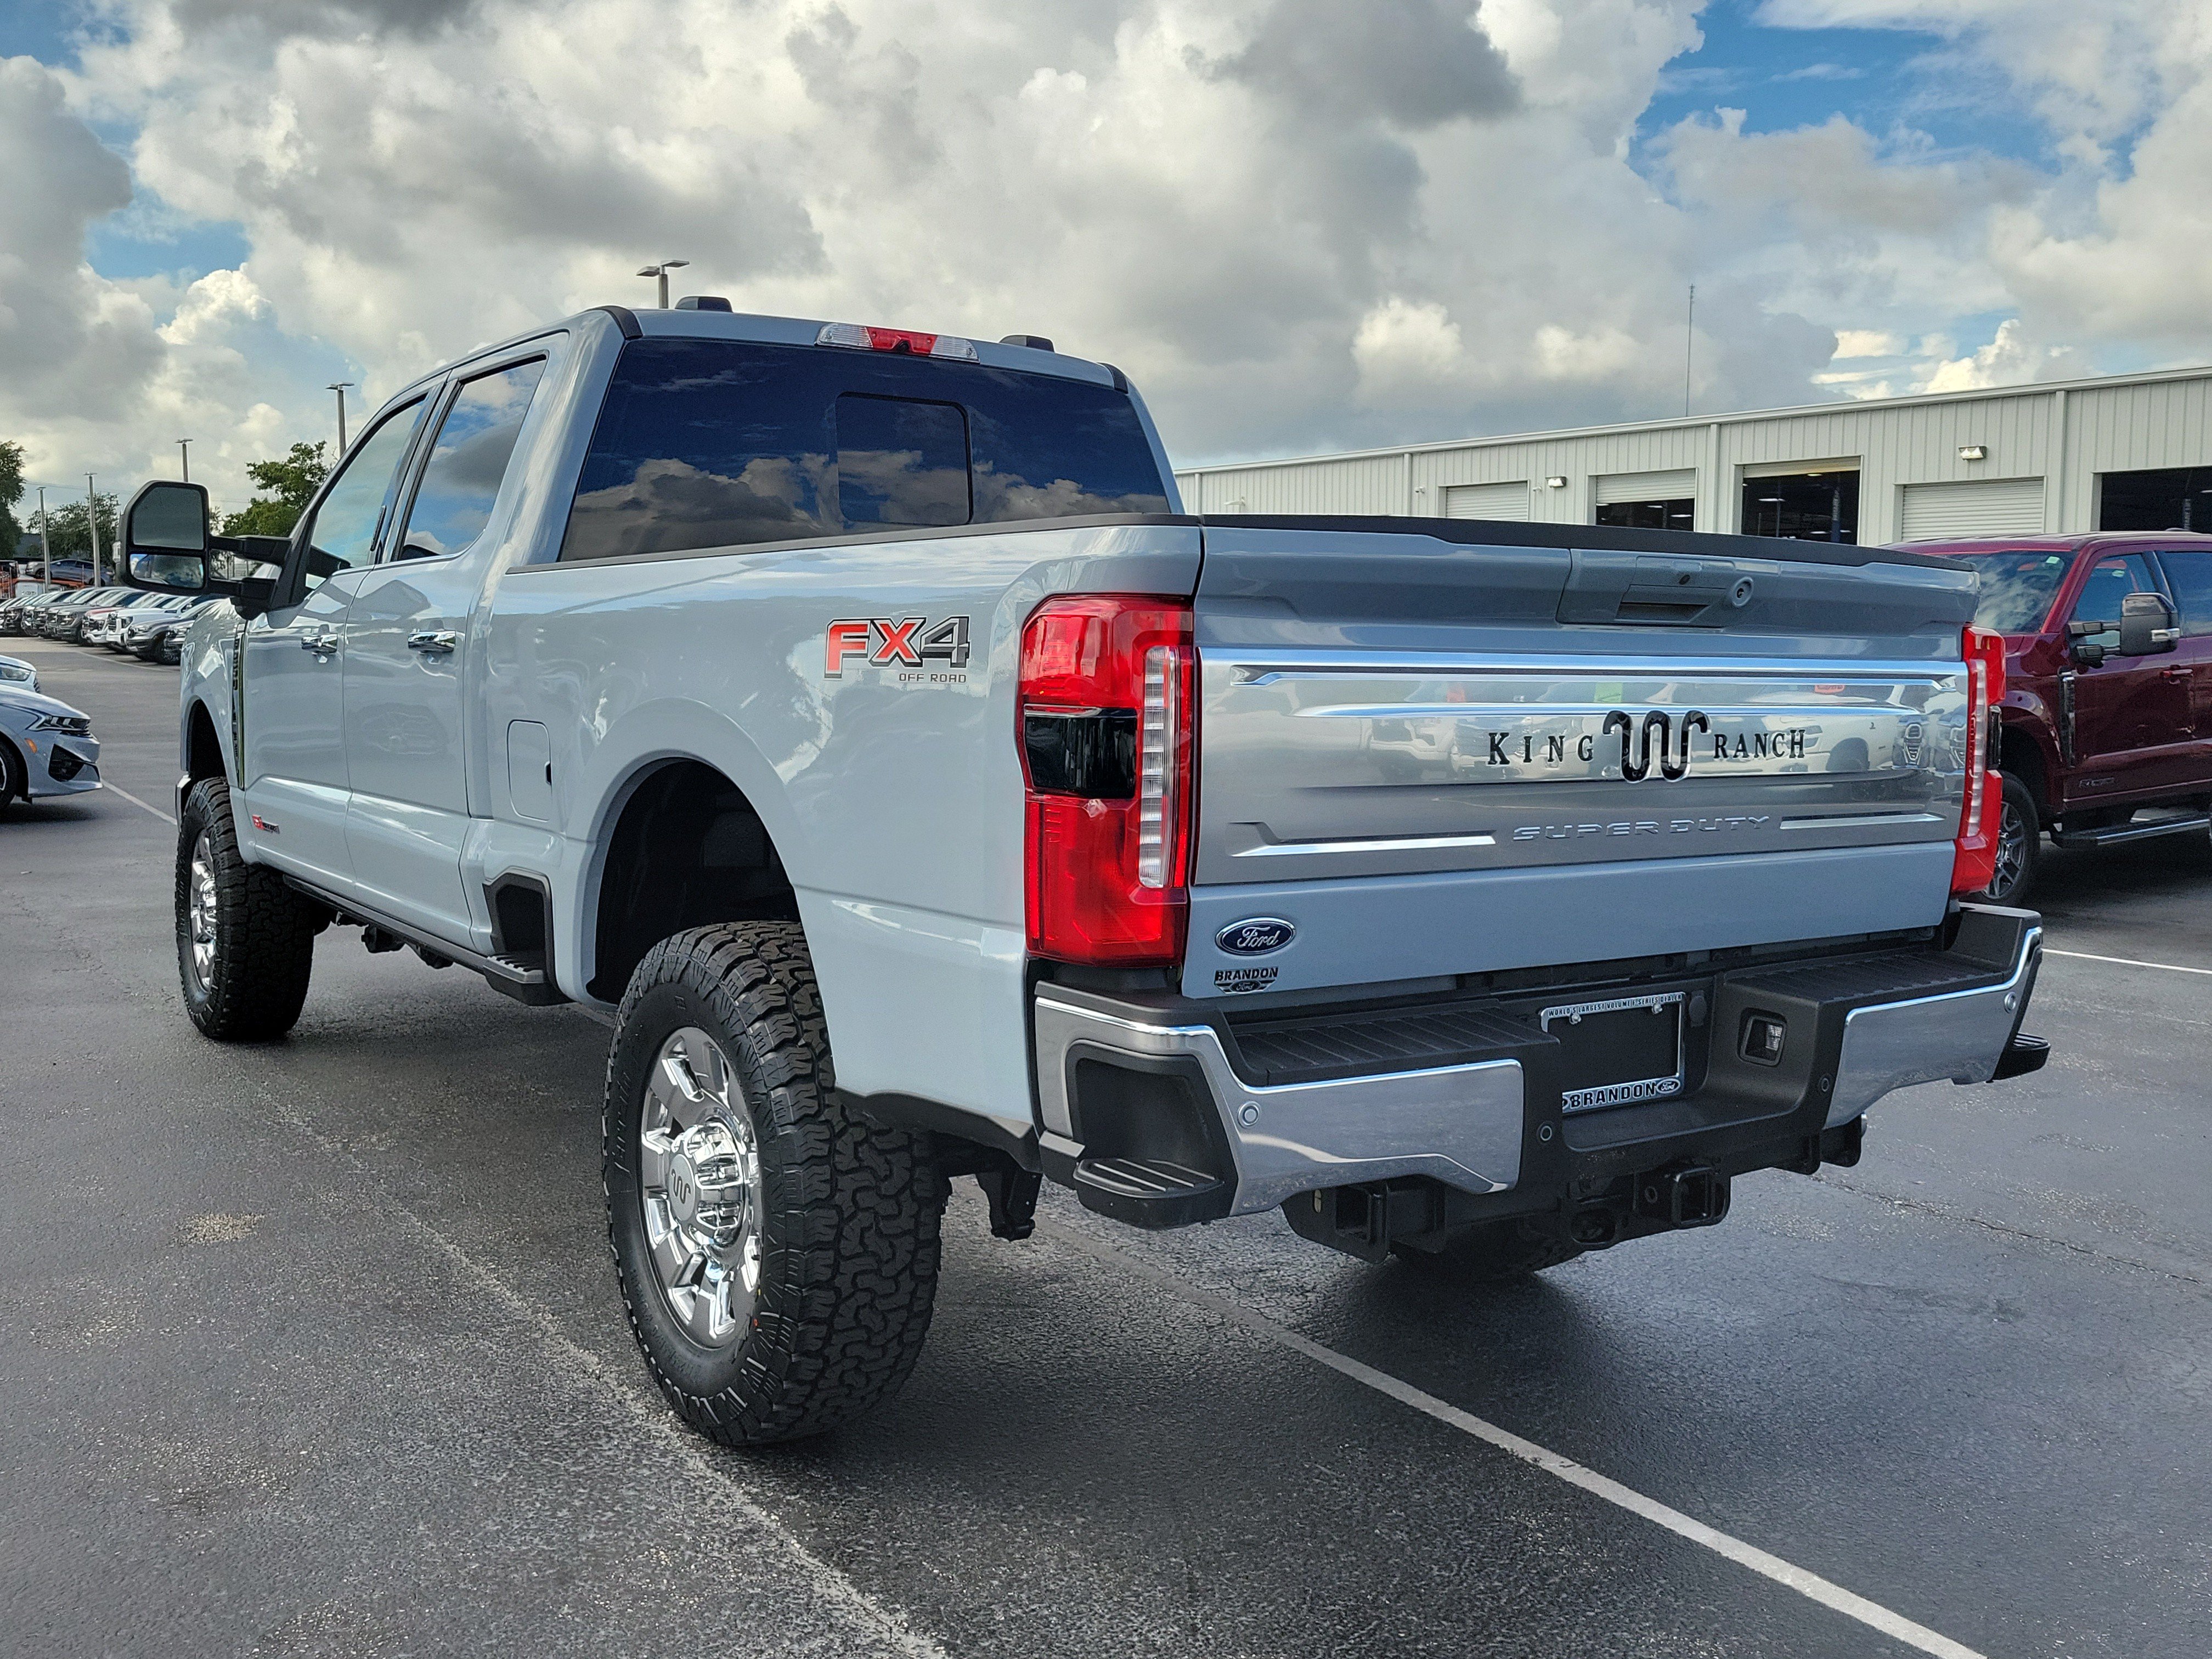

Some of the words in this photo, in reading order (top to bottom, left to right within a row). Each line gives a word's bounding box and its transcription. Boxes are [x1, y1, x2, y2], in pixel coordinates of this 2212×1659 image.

[824, 615, 970, 679] FX4
[899, 673, 925, 682] OFF
[930, 674, 967, 684] ROAD
[1487, 732, 1593, 765] KING
[1713, 729, 1805, 759] RANCH
[1513, 821, 1660, 841] SUPER
[1670, 815, 1770, 834] DUTY
[1237, 926, 1281, 948] Ford
[1215, 967, 1279, 981] BRANDON
[1235, 981, 1254, 991] Ford
[1548, 1007, 1577, 1017] WORLDS
[1578, 1003, 1605, 1013] LARGEST
[1606, 1000, 1630, 1009] VOLUME
[1570, 1081, 1656, 1109] BRANDON
[1661, 1081, 1677, 1091] Ford
